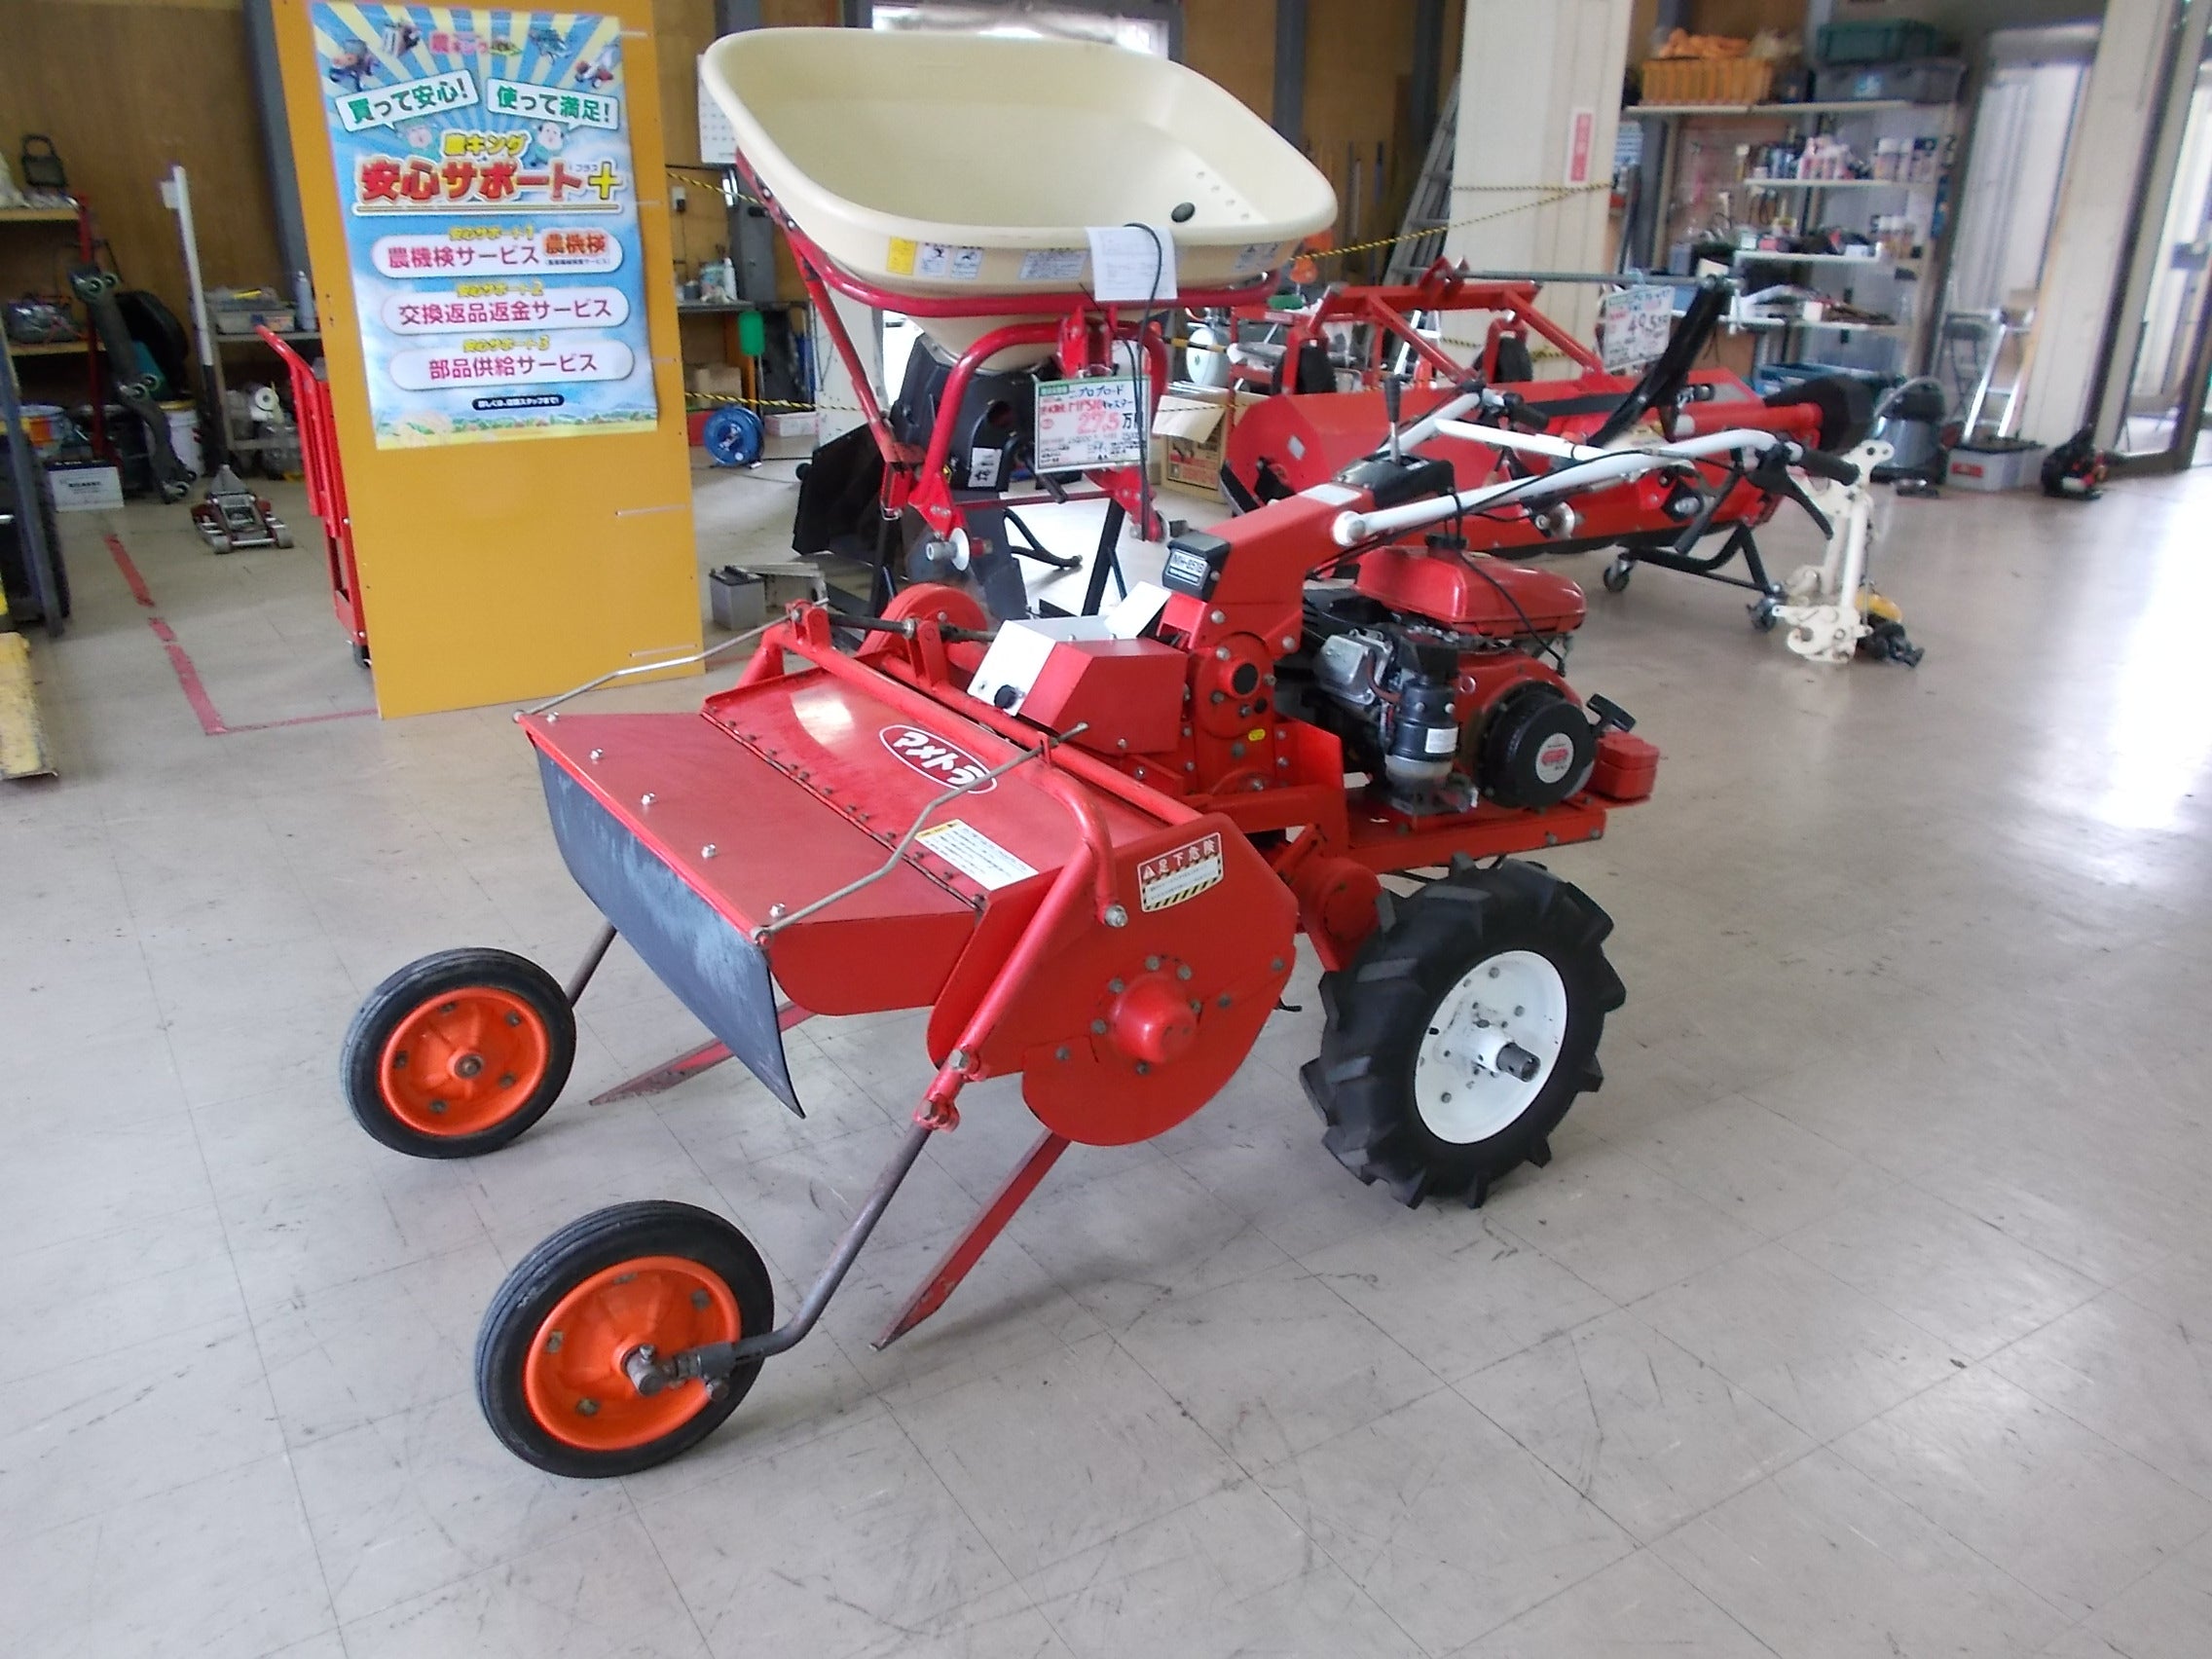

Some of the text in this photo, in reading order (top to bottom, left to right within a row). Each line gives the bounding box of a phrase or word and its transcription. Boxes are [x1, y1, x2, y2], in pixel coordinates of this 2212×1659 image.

[347, 78, 468, 123] 買って安心!
[498, 86, 609, 121] 使って満足!
[387, 245, 539, 269] 農機検サービス
[399, 298, 611, 325] 交換返品返金サービス
[428, 353, 597, 380] 部品供給サービス
